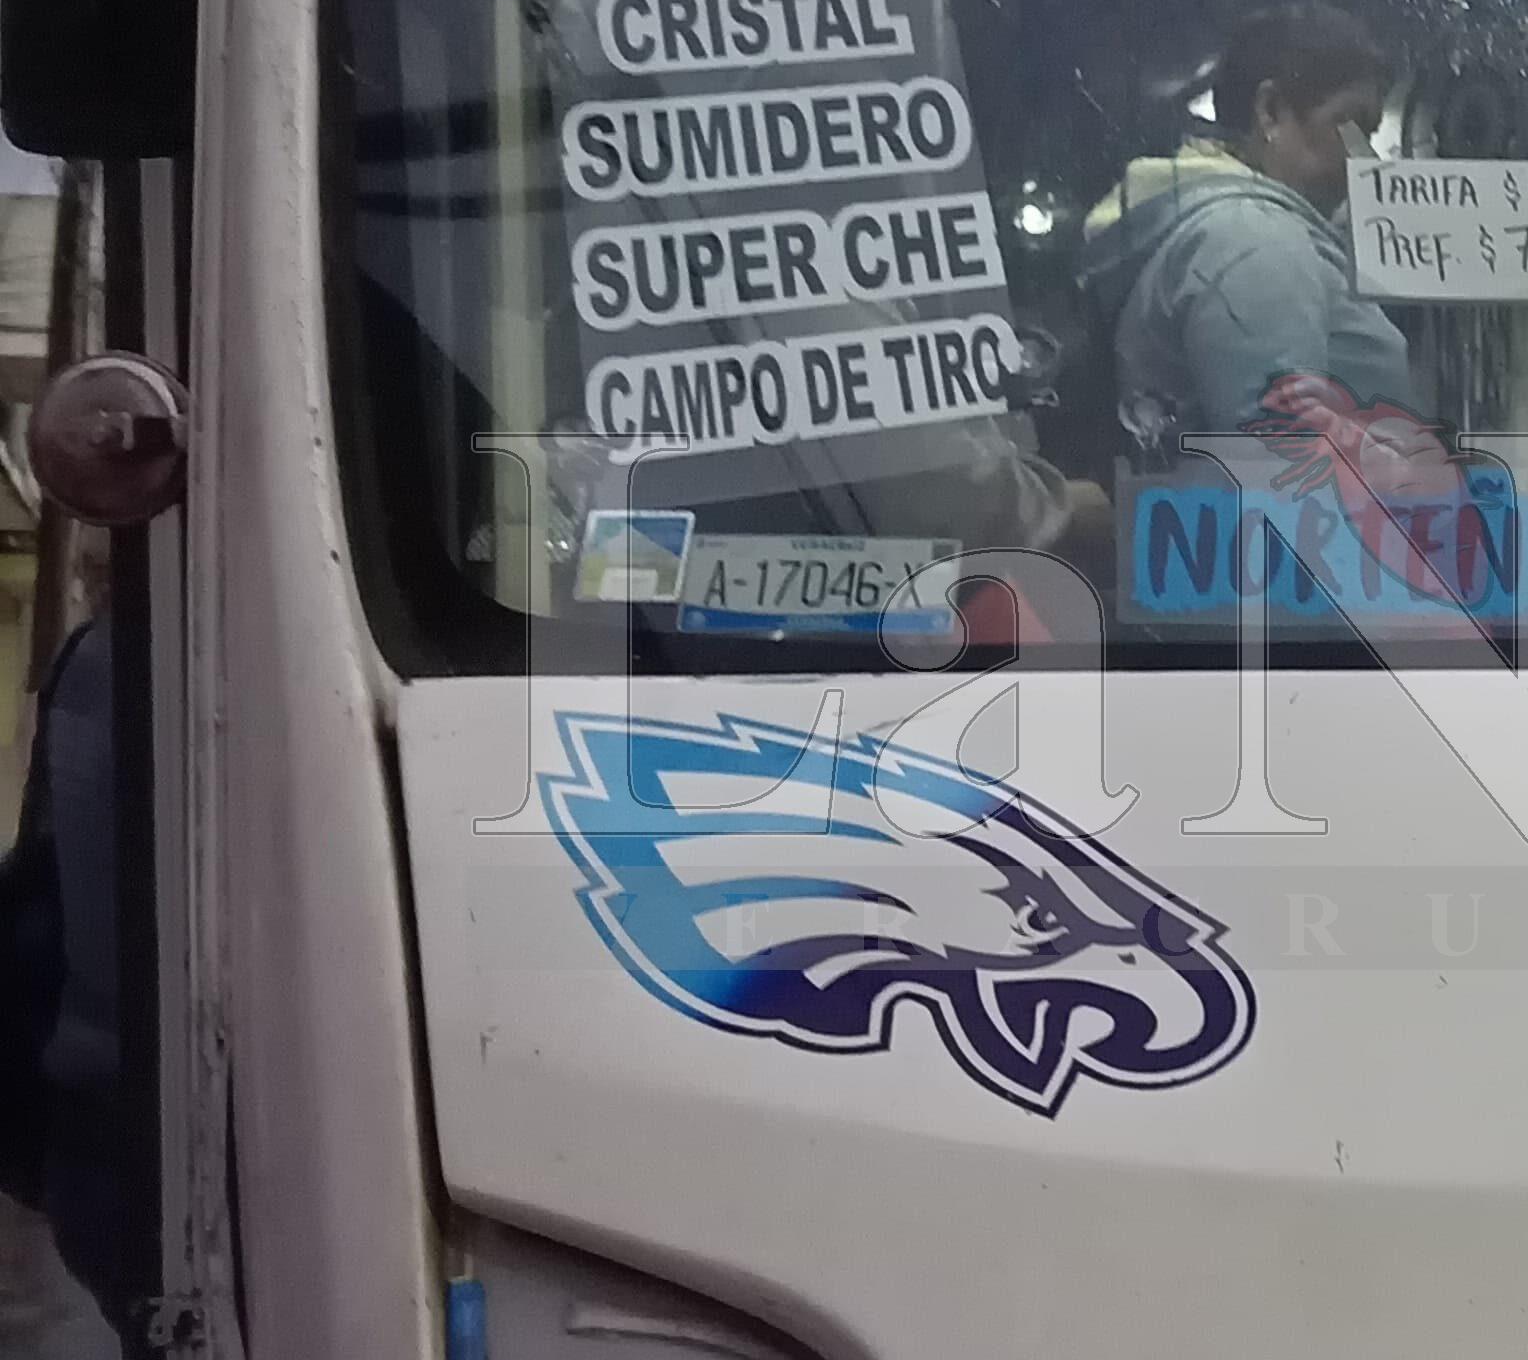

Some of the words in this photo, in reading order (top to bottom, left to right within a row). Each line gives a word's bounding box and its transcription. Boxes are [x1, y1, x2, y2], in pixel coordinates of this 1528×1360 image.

[576, 88, 957, 190] SUMIDERO
[1360, 161, 1480, 207] TARIFA
[586, 221, 828, 319] SUPER
[842, 204, 989, 290] CHE
[600, 351, 789, 448] CAMPO
[803, 341, 876, 424] DE
[880, 324, 1004, 415] TIRO
[702, 558, 924, 610] A-17046-X
